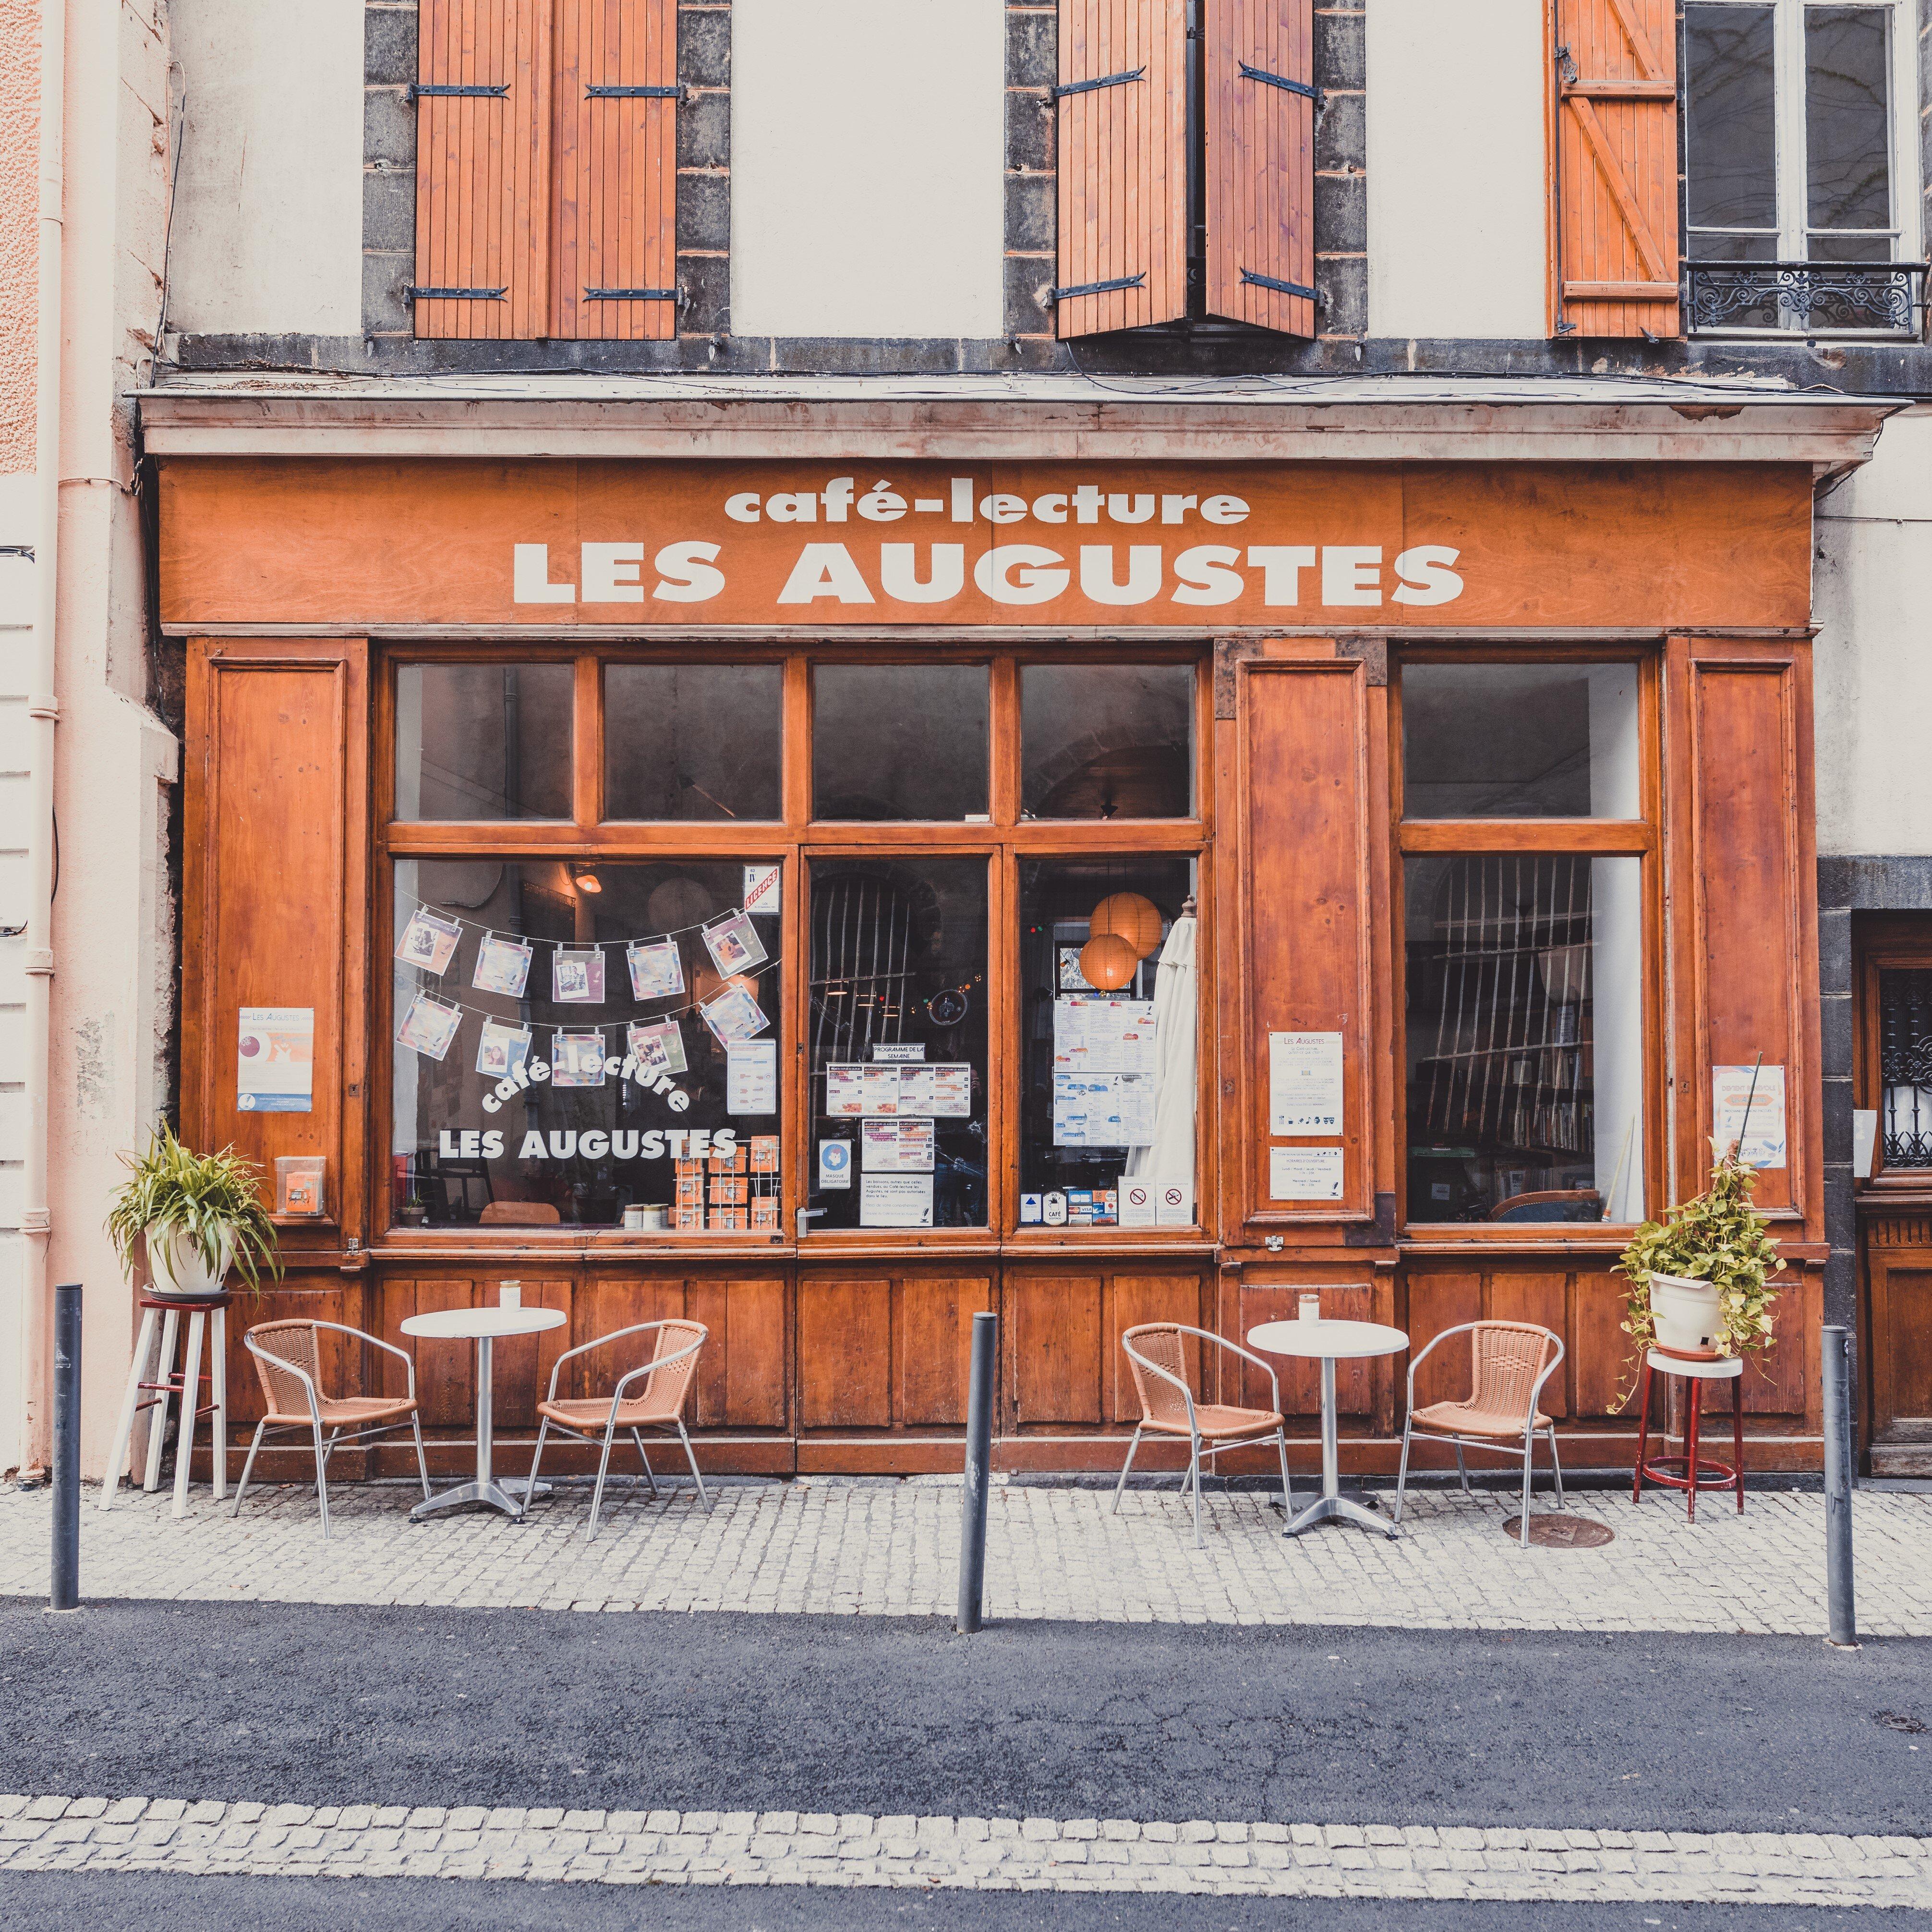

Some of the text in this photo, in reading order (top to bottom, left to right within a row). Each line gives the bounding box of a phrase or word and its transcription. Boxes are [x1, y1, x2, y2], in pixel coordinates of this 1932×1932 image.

[724, 477, 1250, 524] café-lecture
[514, 541, 1464, 606] LES AUGUSTES
[747, 870, 777, 907] LICENCE
[482, 1044, 689, 1113] café-lecture
[439, 1129, 737, 1159] LES AUGUSTES
